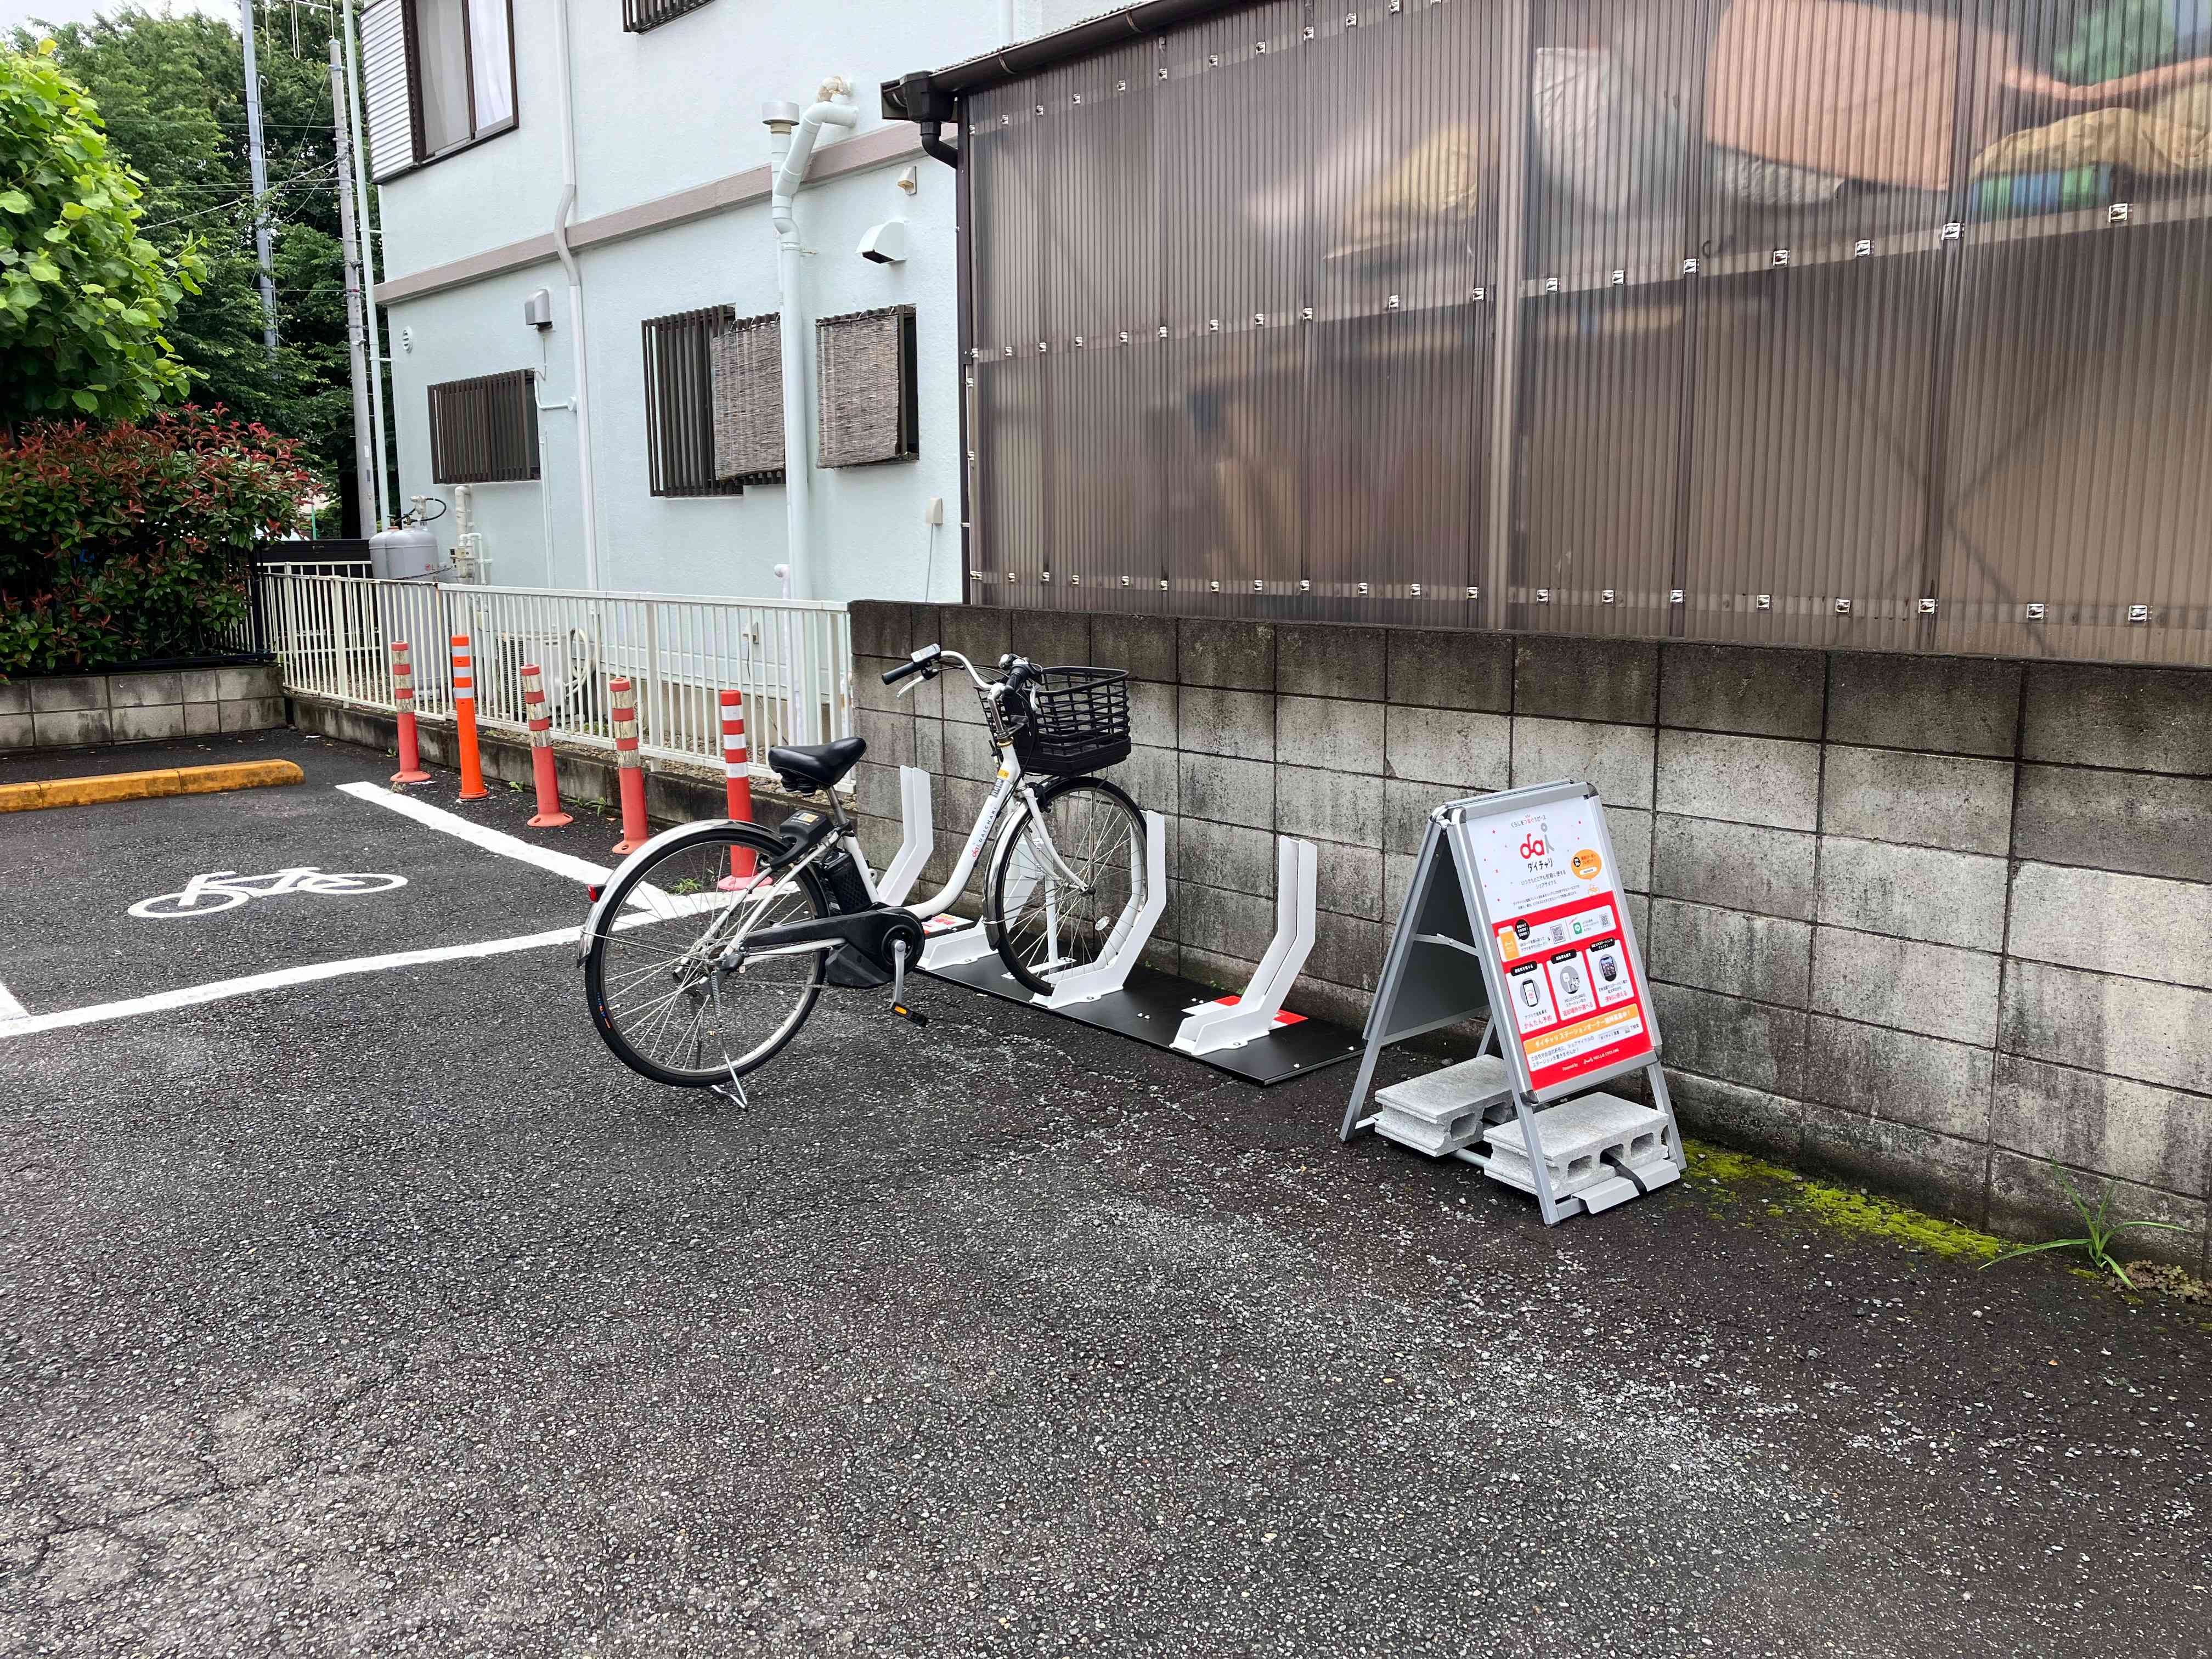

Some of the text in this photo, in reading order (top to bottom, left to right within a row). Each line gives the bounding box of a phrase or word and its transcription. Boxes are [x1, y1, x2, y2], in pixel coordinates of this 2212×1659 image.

[979, 808, 997, 842] DAICHARI
[1528, 858, 1553, 873] ダイチャリ
[1523, 1014, 1553, 1029] かんたん予約
[1605, 1047, 1619, 1056] CYCLING
